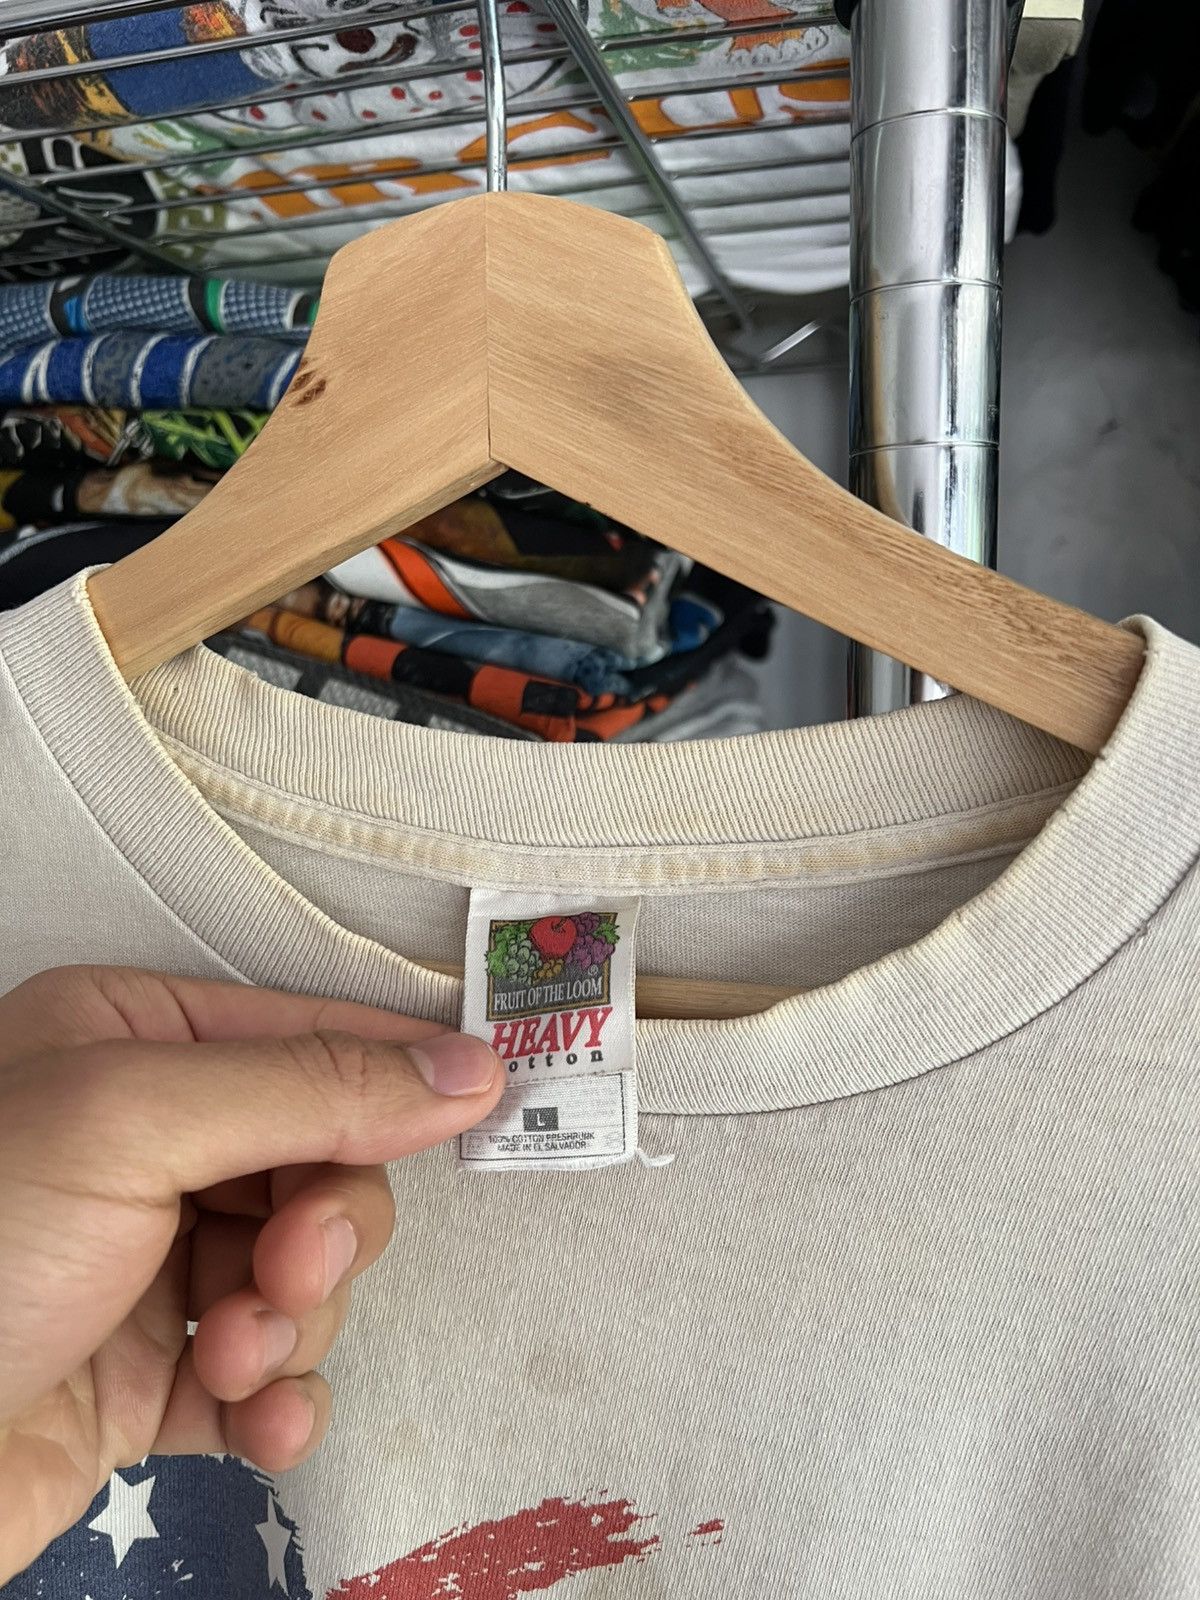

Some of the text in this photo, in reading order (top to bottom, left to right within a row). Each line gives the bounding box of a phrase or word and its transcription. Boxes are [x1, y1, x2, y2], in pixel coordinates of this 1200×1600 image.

[494, 976, 603, 1011] FRUIT OF THE LOOM
[491, 1006, 614, 1060] HEAVY
[507, 1049, 604, 1073] otton
[536, 1112, 546, 1127] L
[488, 1131, 595, 1144] 100% COTTON PRESHRUNK
[497, 1140, 588, 1152] MADE IN EL SALVADOR
